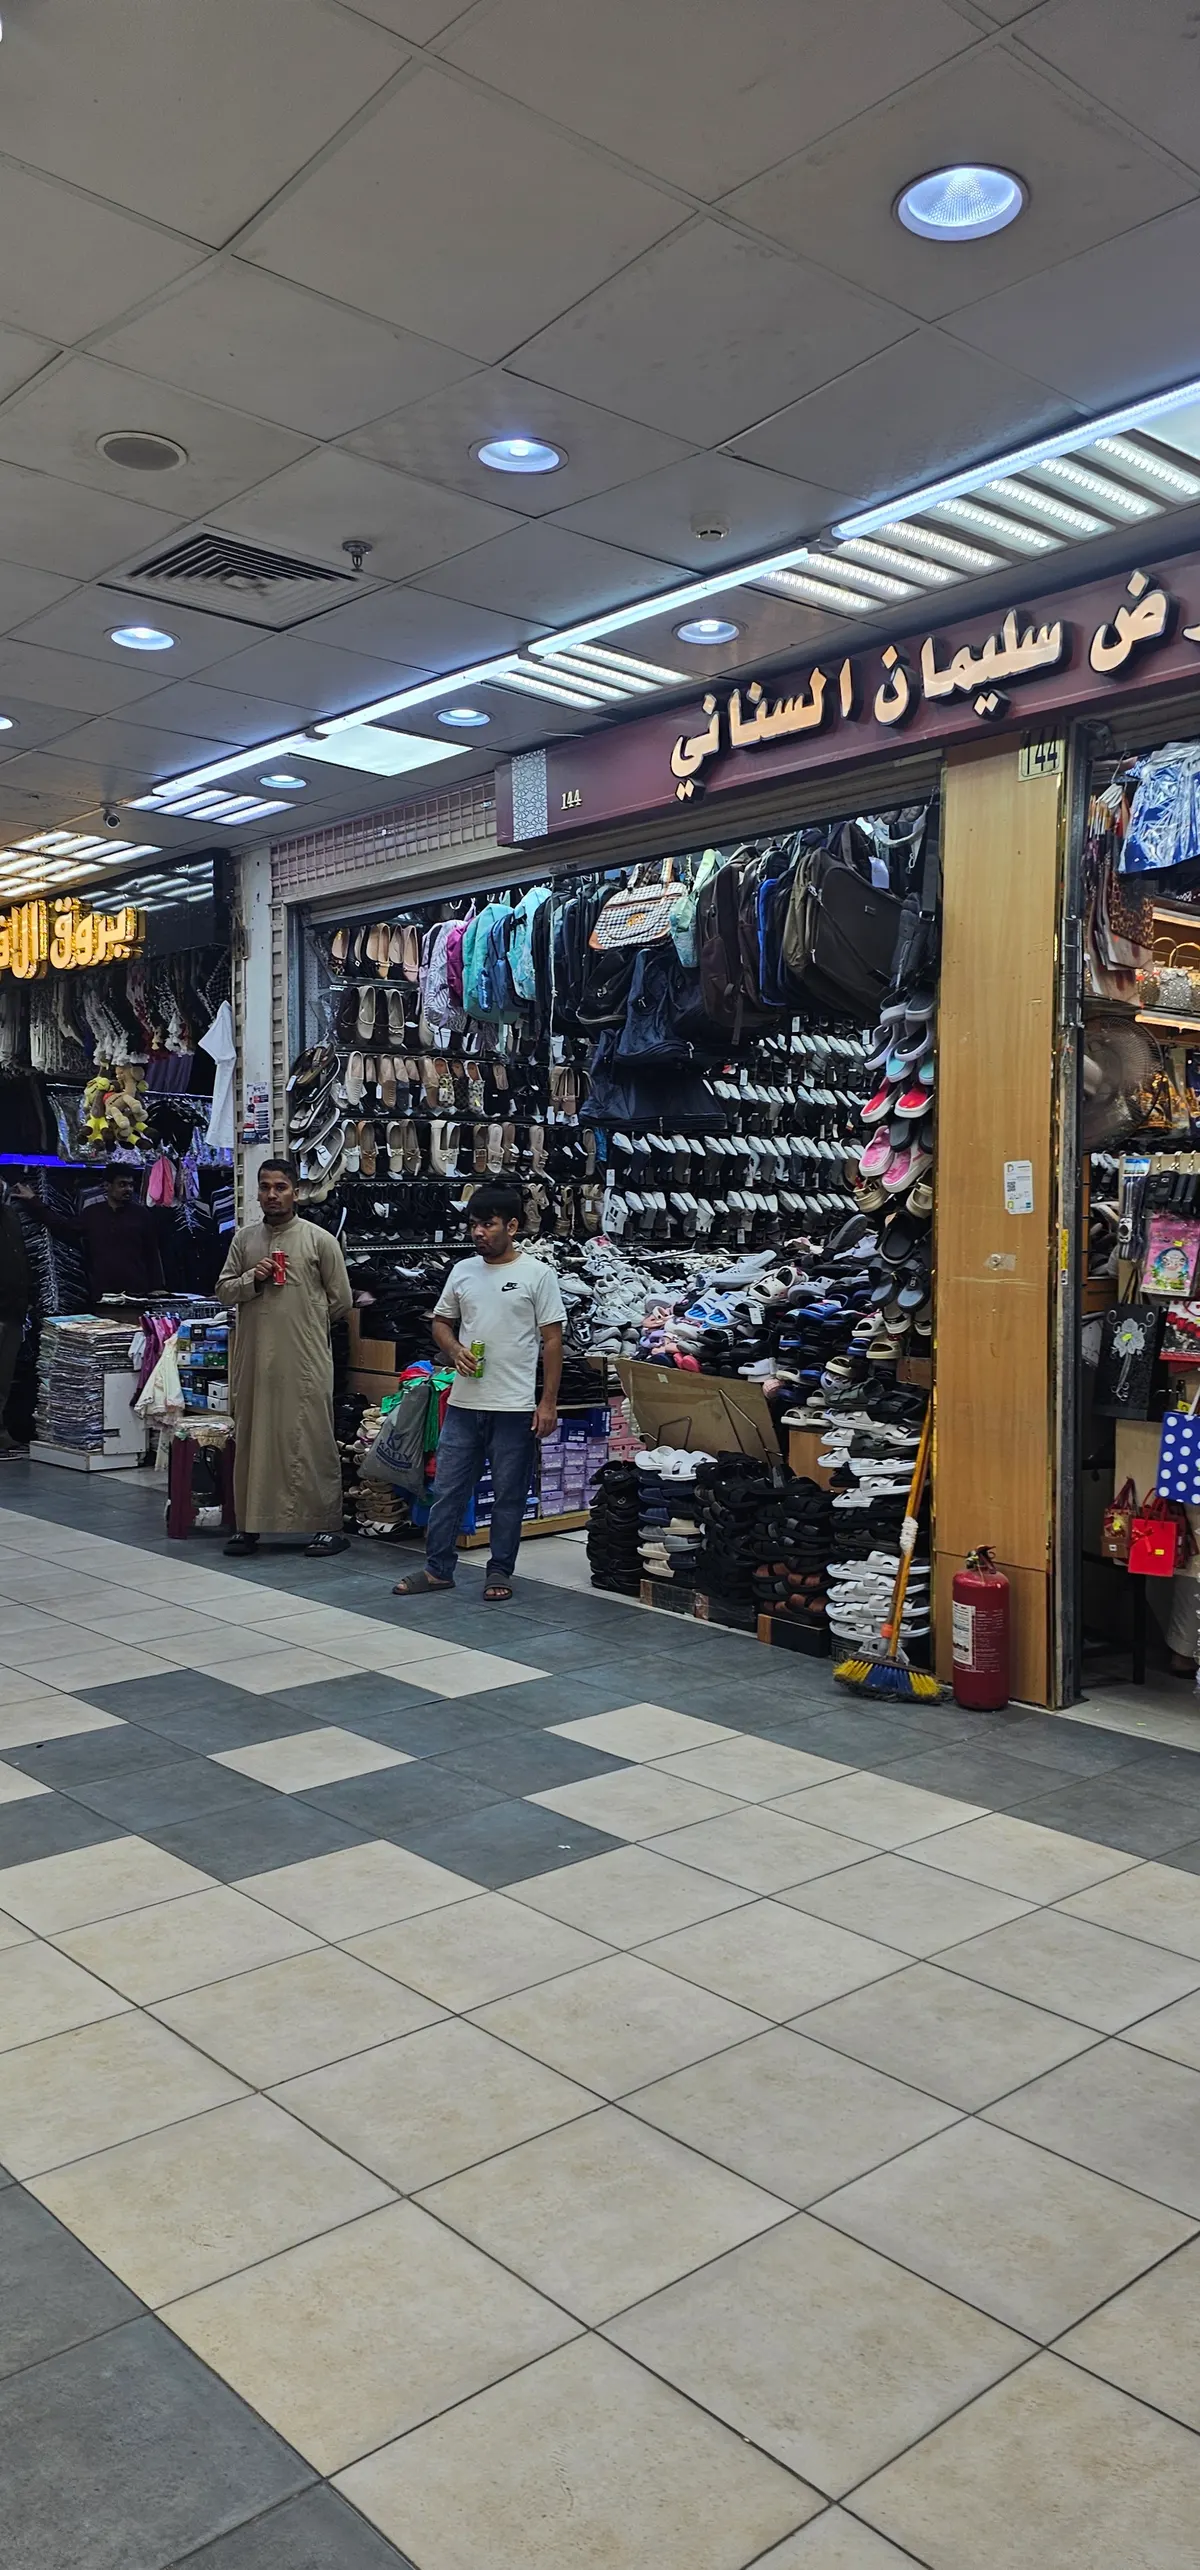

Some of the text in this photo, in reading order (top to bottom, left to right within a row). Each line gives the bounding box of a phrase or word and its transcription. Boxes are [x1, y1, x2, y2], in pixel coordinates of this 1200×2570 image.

[873, 607, 1064, 726] سليمان
[669, 656, 854, 802] السناني
[1022, 725, 1058, 775] 144
[560, 788, 583, 811] 144
[50, 896, 136, 970] بروق
